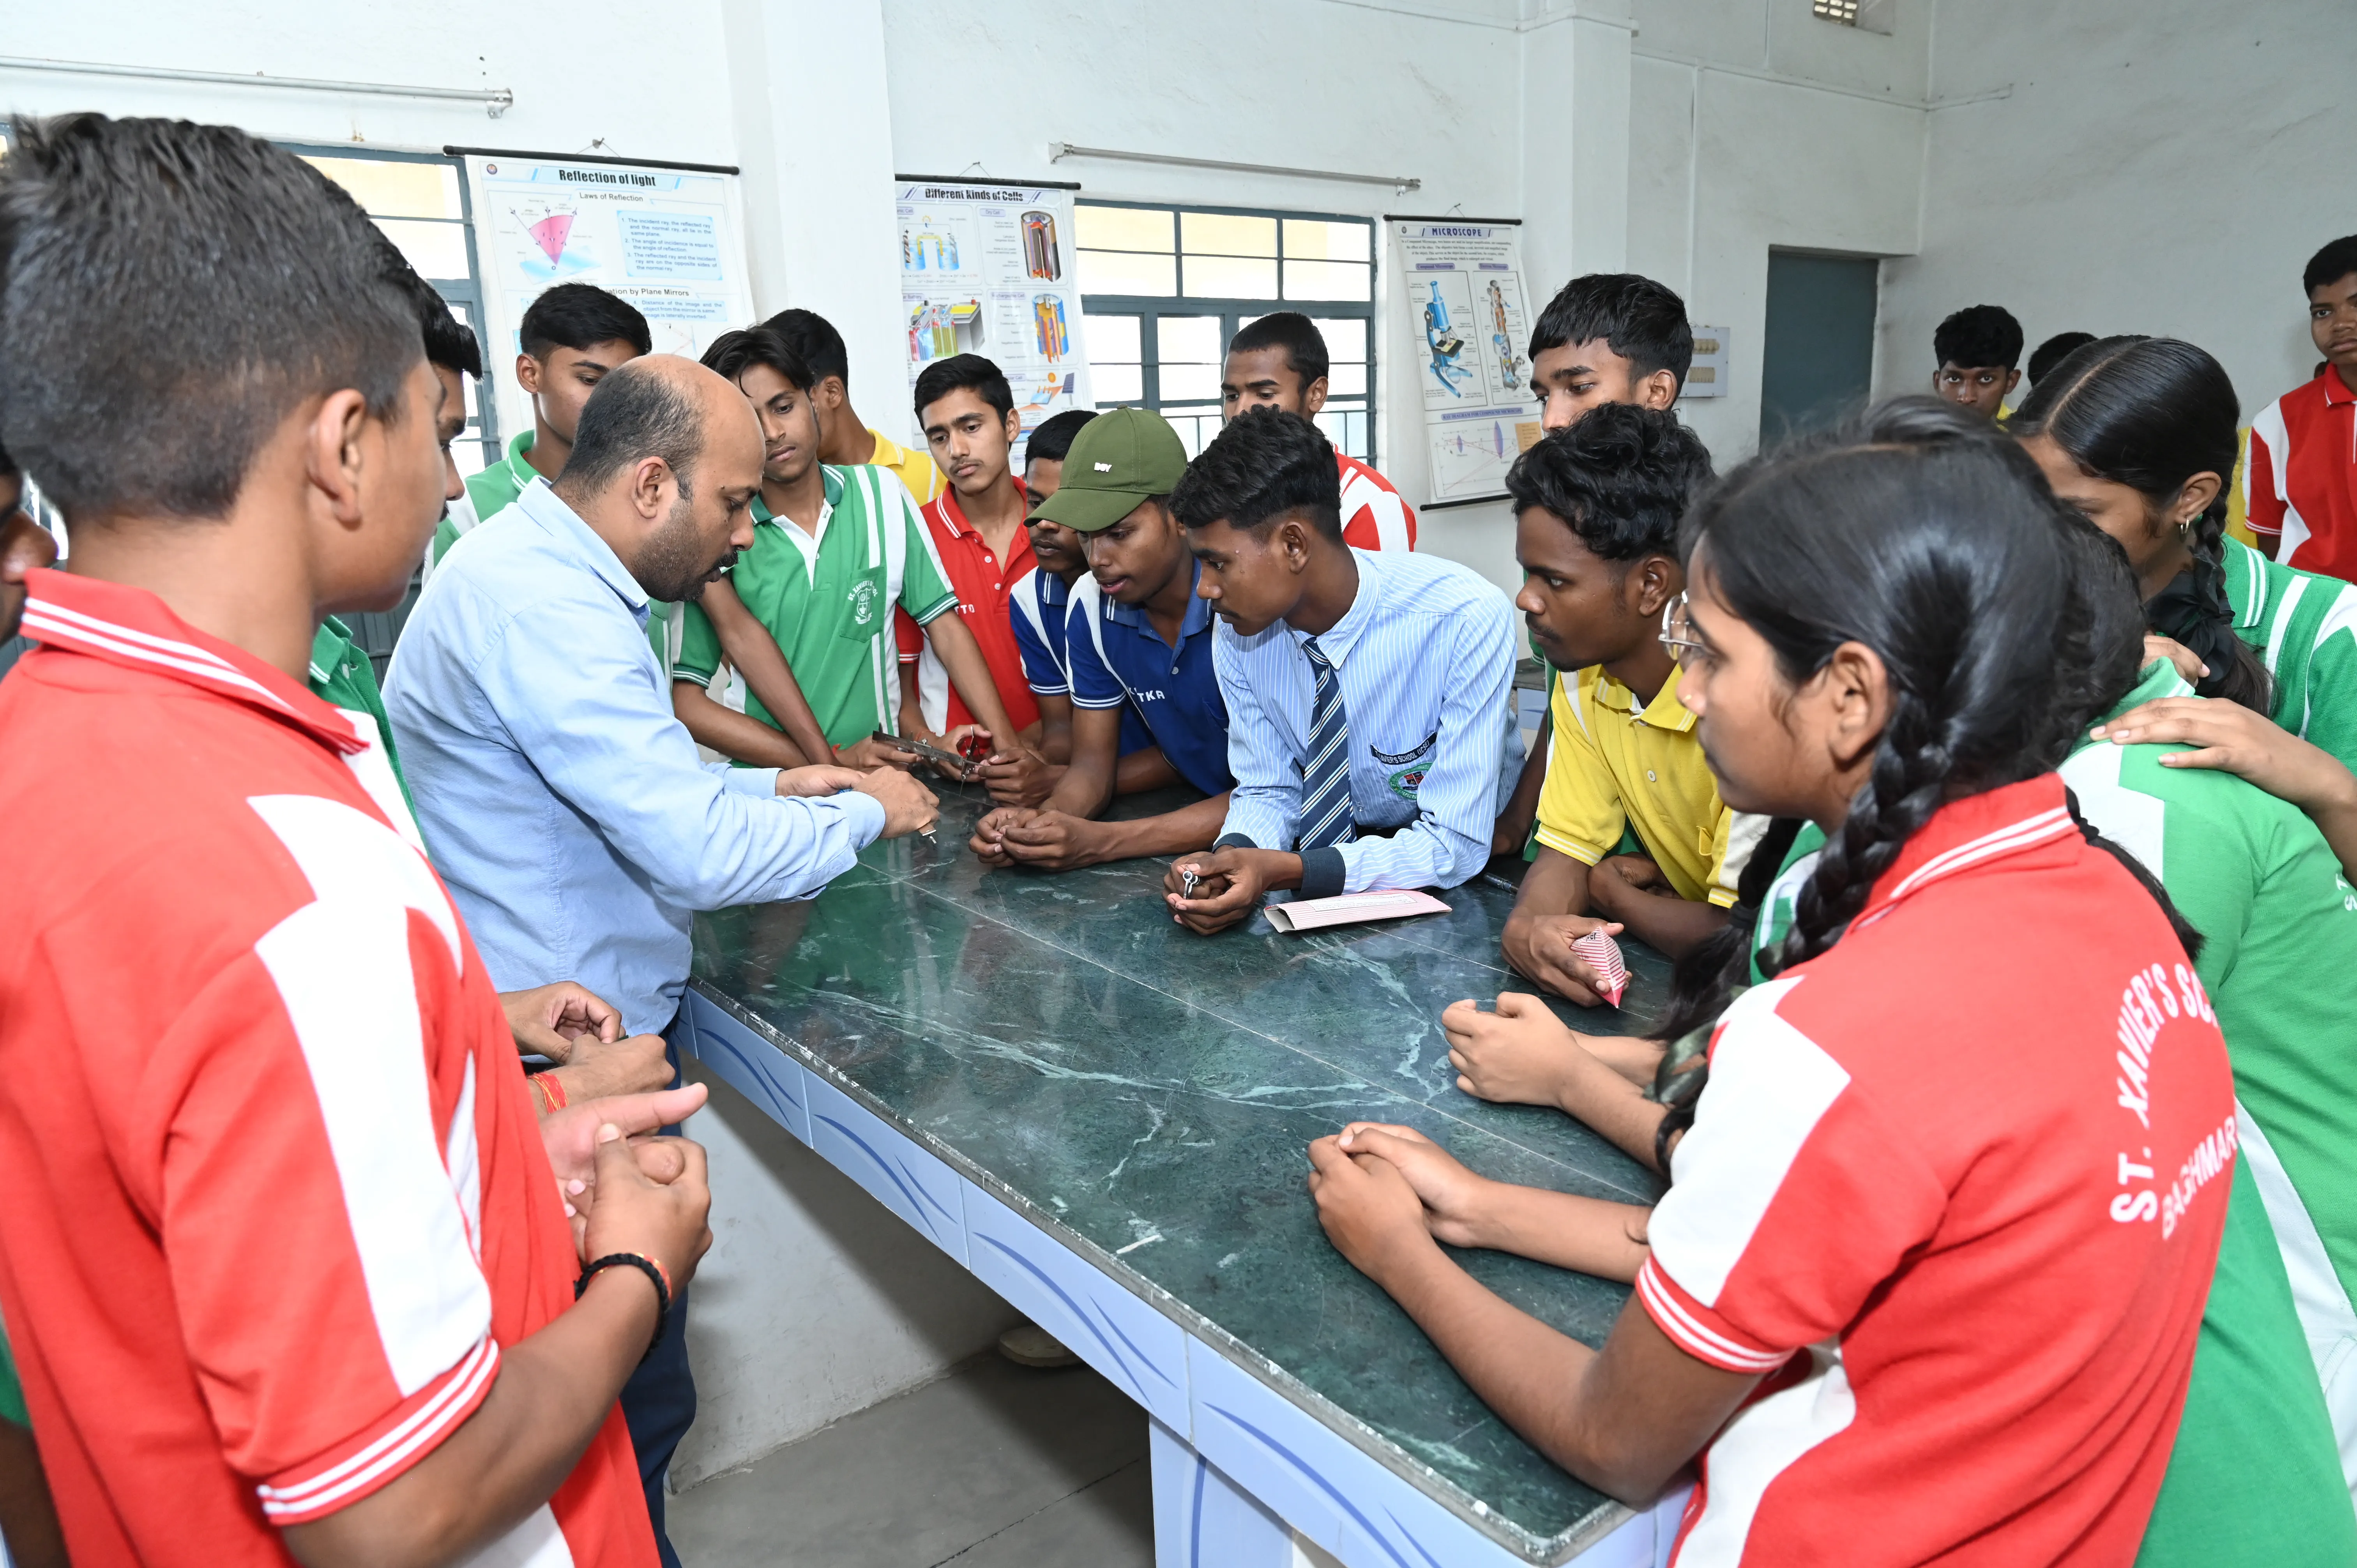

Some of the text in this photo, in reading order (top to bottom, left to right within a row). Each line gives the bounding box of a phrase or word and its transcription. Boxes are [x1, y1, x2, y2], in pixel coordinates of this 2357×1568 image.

[559, 170, 656, 186] Reflection of light
[925, 188, 1023, 201] Different Kinds of Cells
[1432, 228, 1482, 237] MICROSCOPE
[1398, 751, 1417, 763] SCHOOL
[1417, 740, 1429, 755] (ICSE)
[2117, 963, 2179, 1130] XAVIER'S
[2109, 1146, 2158, 1222] ST.
[2162, 1115, 2238, 1241] BAGHMAR
